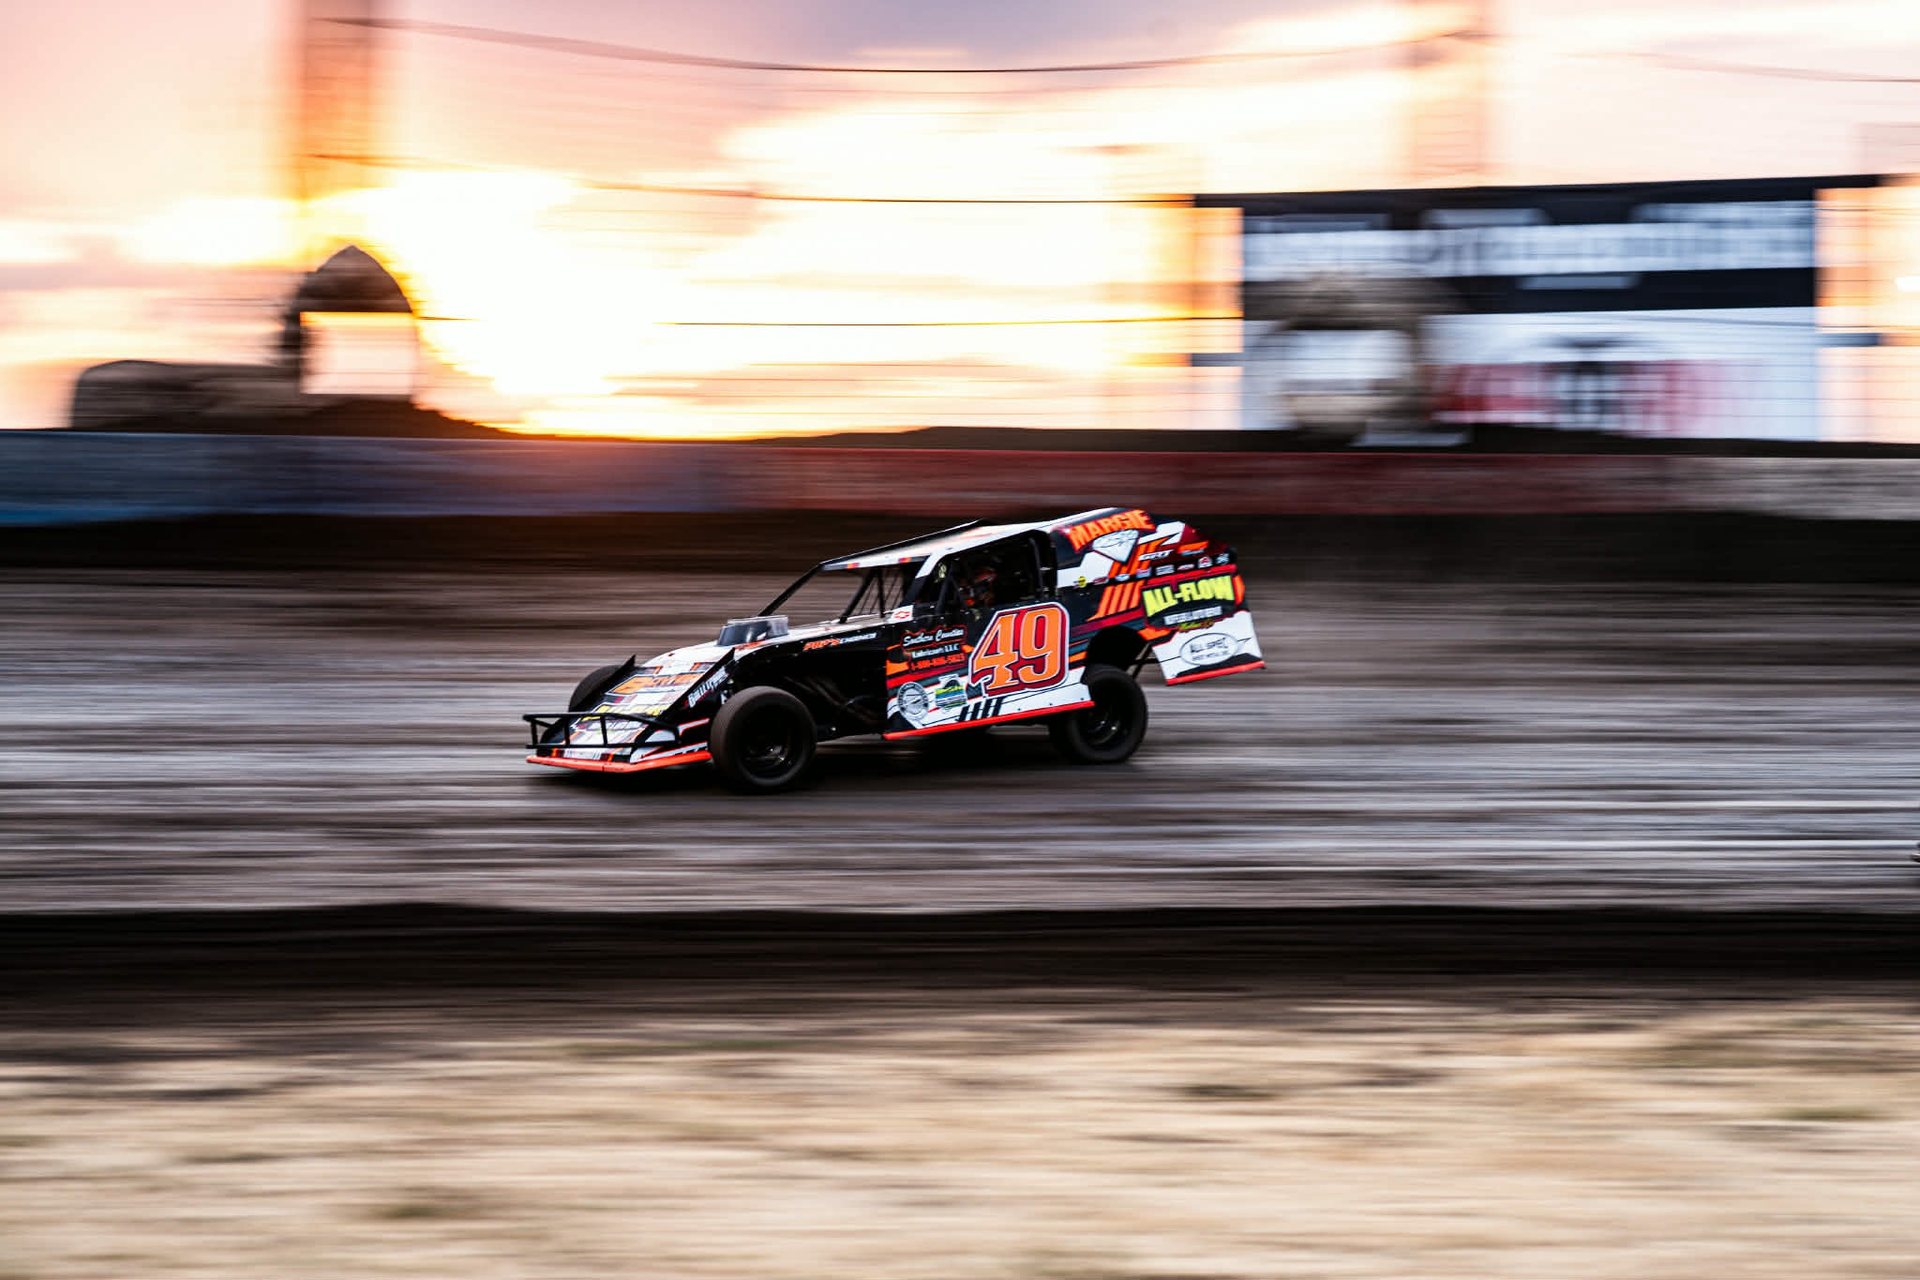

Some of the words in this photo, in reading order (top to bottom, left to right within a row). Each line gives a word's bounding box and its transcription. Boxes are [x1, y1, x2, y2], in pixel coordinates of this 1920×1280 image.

[1069, 509, 1155, 552] MARGIE
[1142, 575, 1235, 617] ALL-FLOW
[971, 603, 1068, 694] 49
